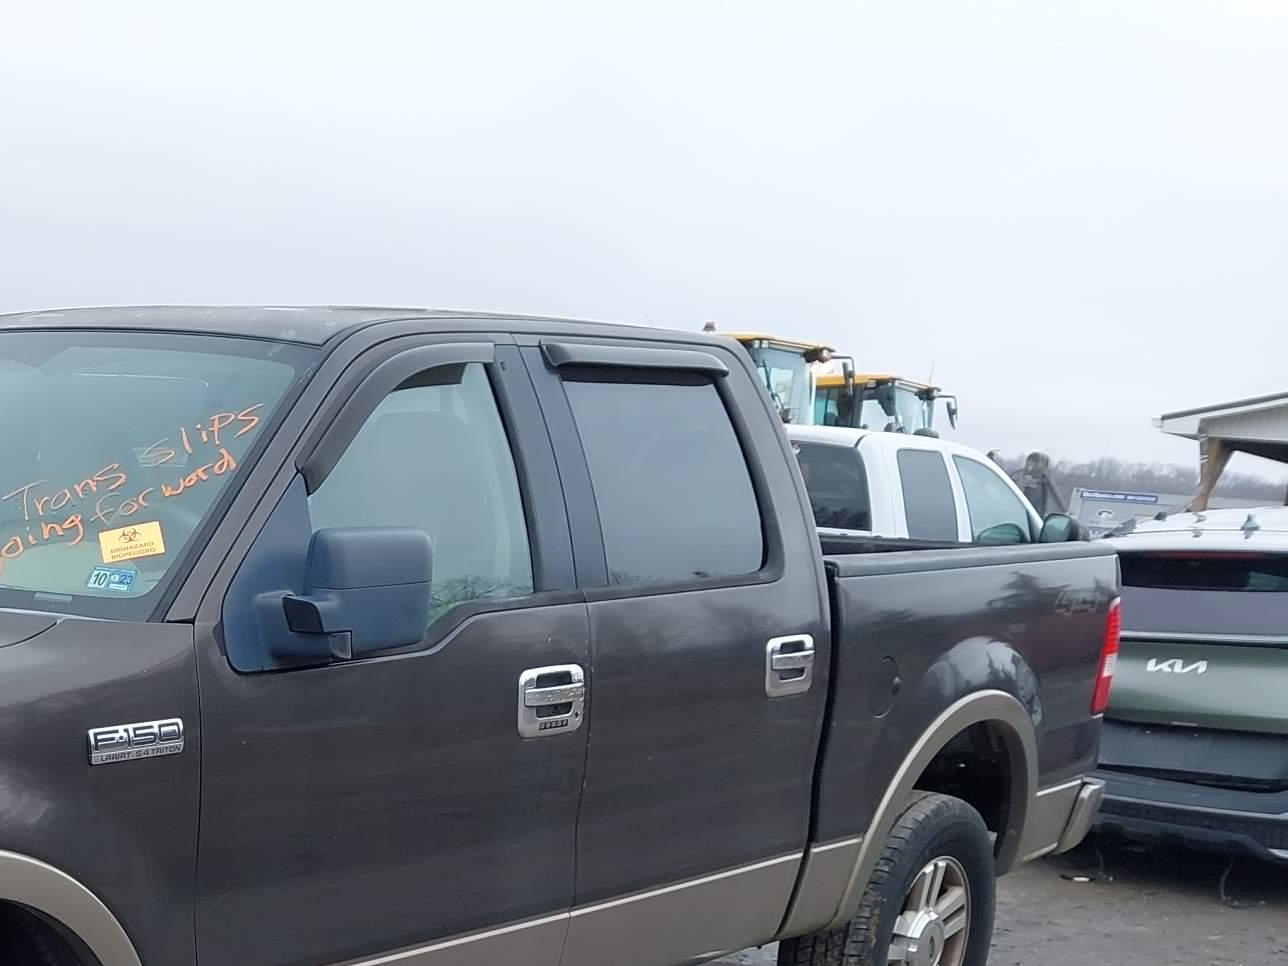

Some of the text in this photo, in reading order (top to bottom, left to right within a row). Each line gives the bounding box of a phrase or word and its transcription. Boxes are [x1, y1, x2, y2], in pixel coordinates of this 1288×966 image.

[1, 463, 127, 520] Trans
[93, 572, 108, 586] 10
[1146, 658, 1208, 675] KIA
